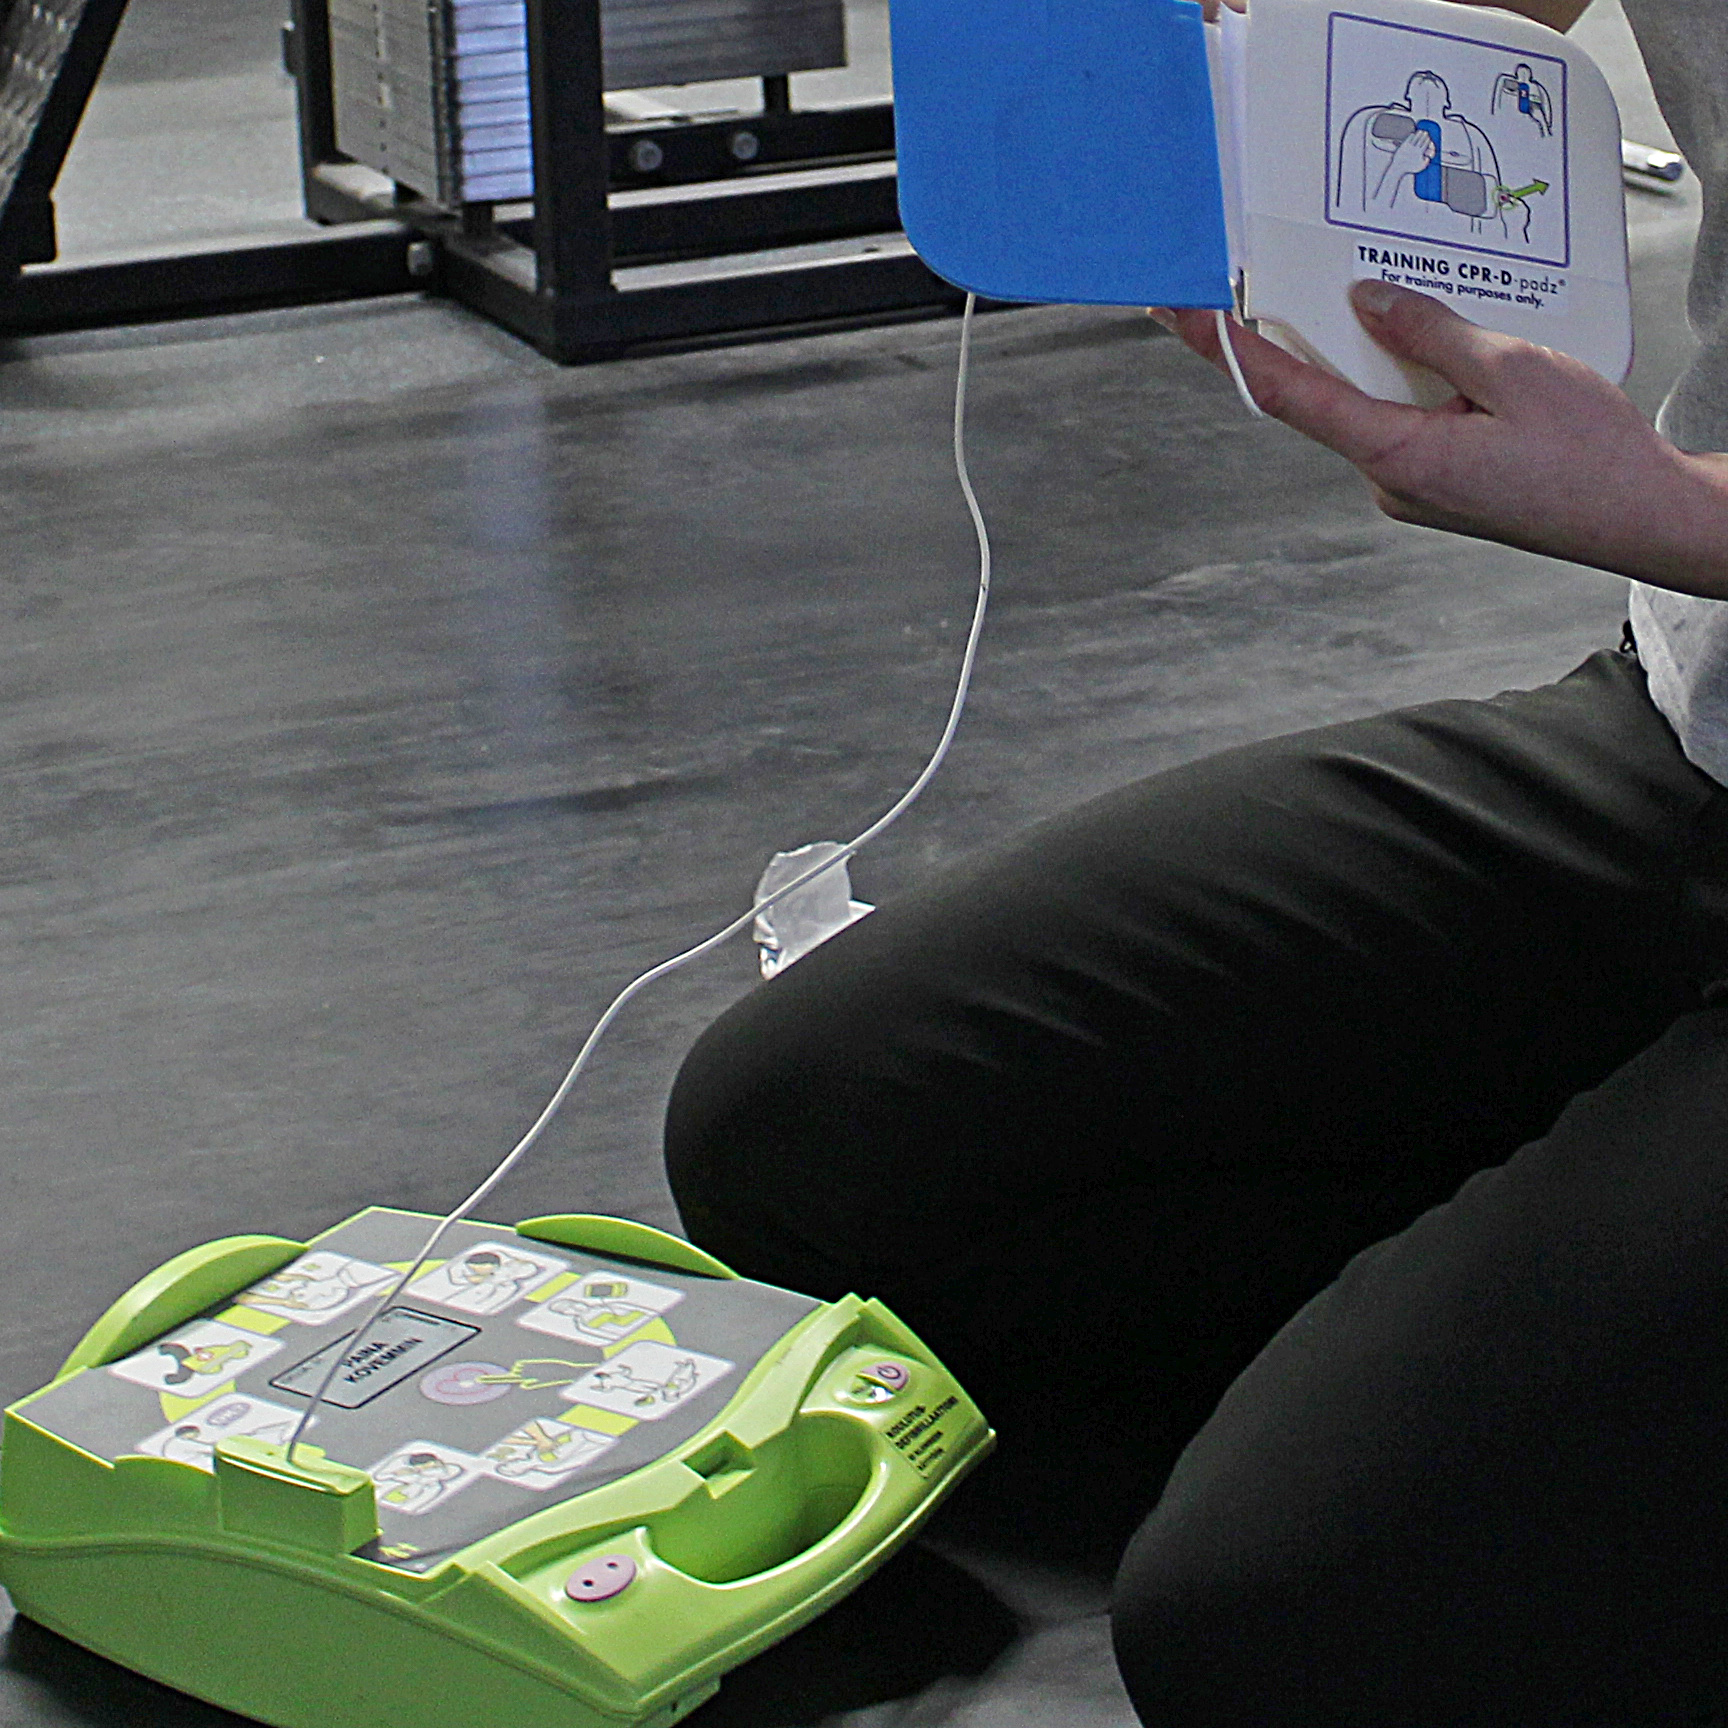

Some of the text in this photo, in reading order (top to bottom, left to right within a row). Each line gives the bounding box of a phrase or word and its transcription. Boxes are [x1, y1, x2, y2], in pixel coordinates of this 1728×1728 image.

[1357, 246, 1450, 275] TRAINING
[1381, 269, 1545, 310] For training purposes only.
